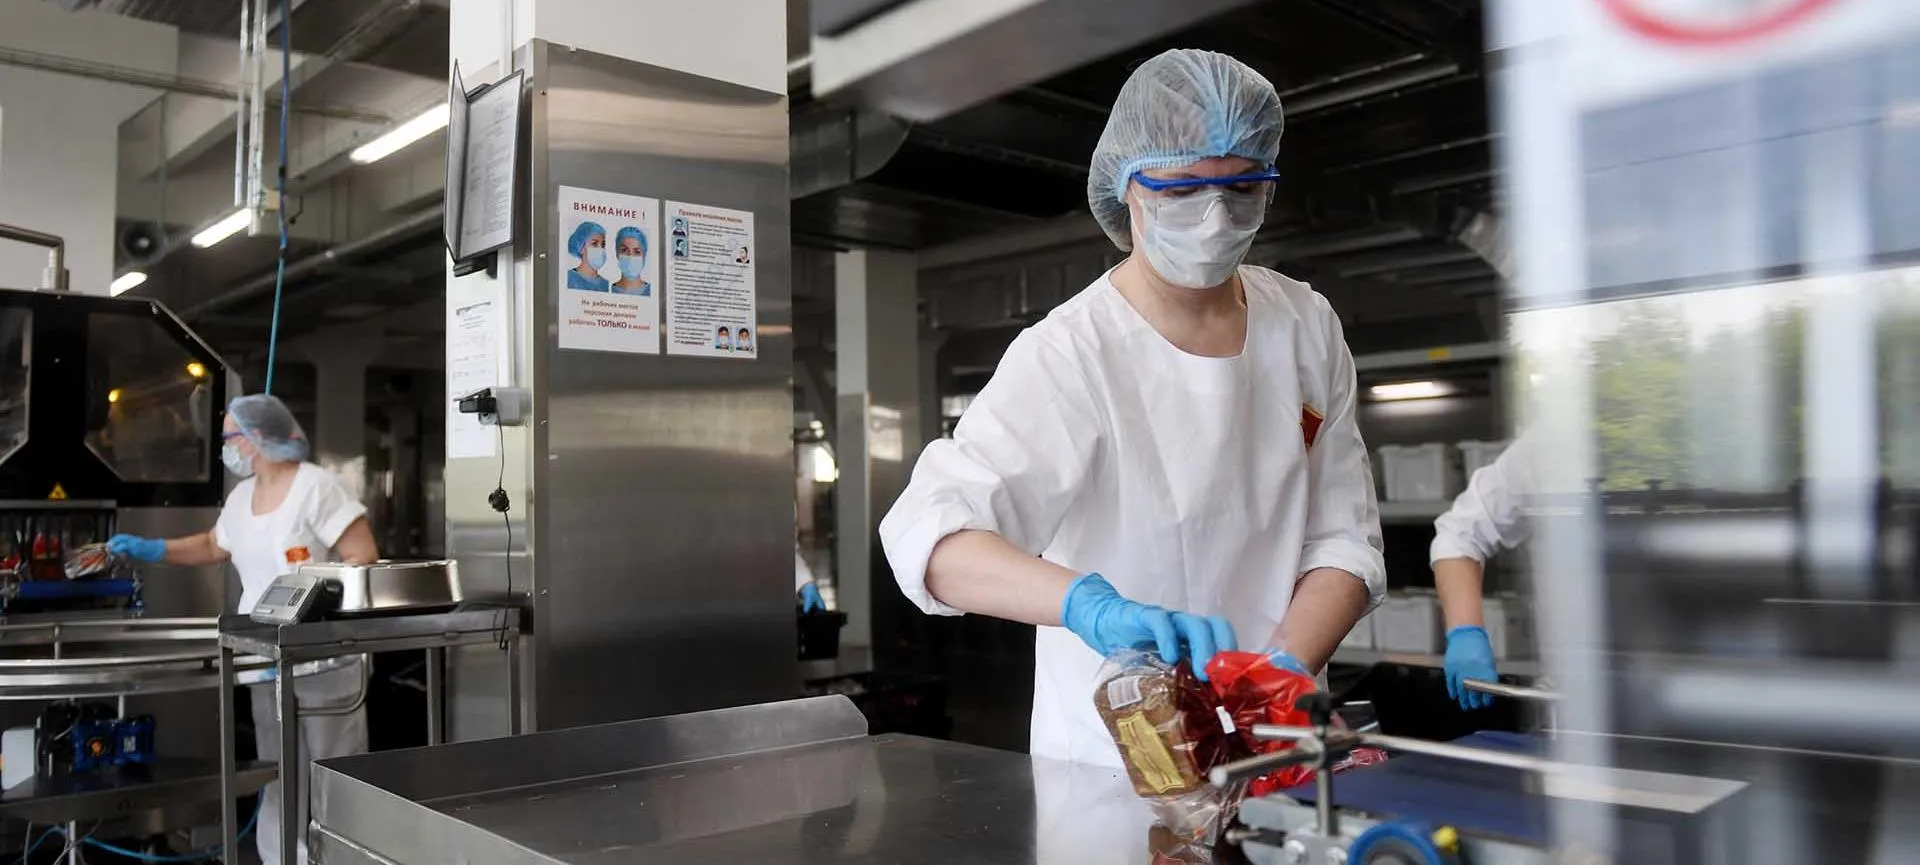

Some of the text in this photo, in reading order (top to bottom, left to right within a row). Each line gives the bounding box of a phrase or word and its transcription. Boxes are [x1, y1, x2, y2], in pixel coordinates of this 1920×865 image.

[573, 202, 646, 220] ВНИМАНИЕ !
[597, 319, 628, 329] ТОЛЬКО
